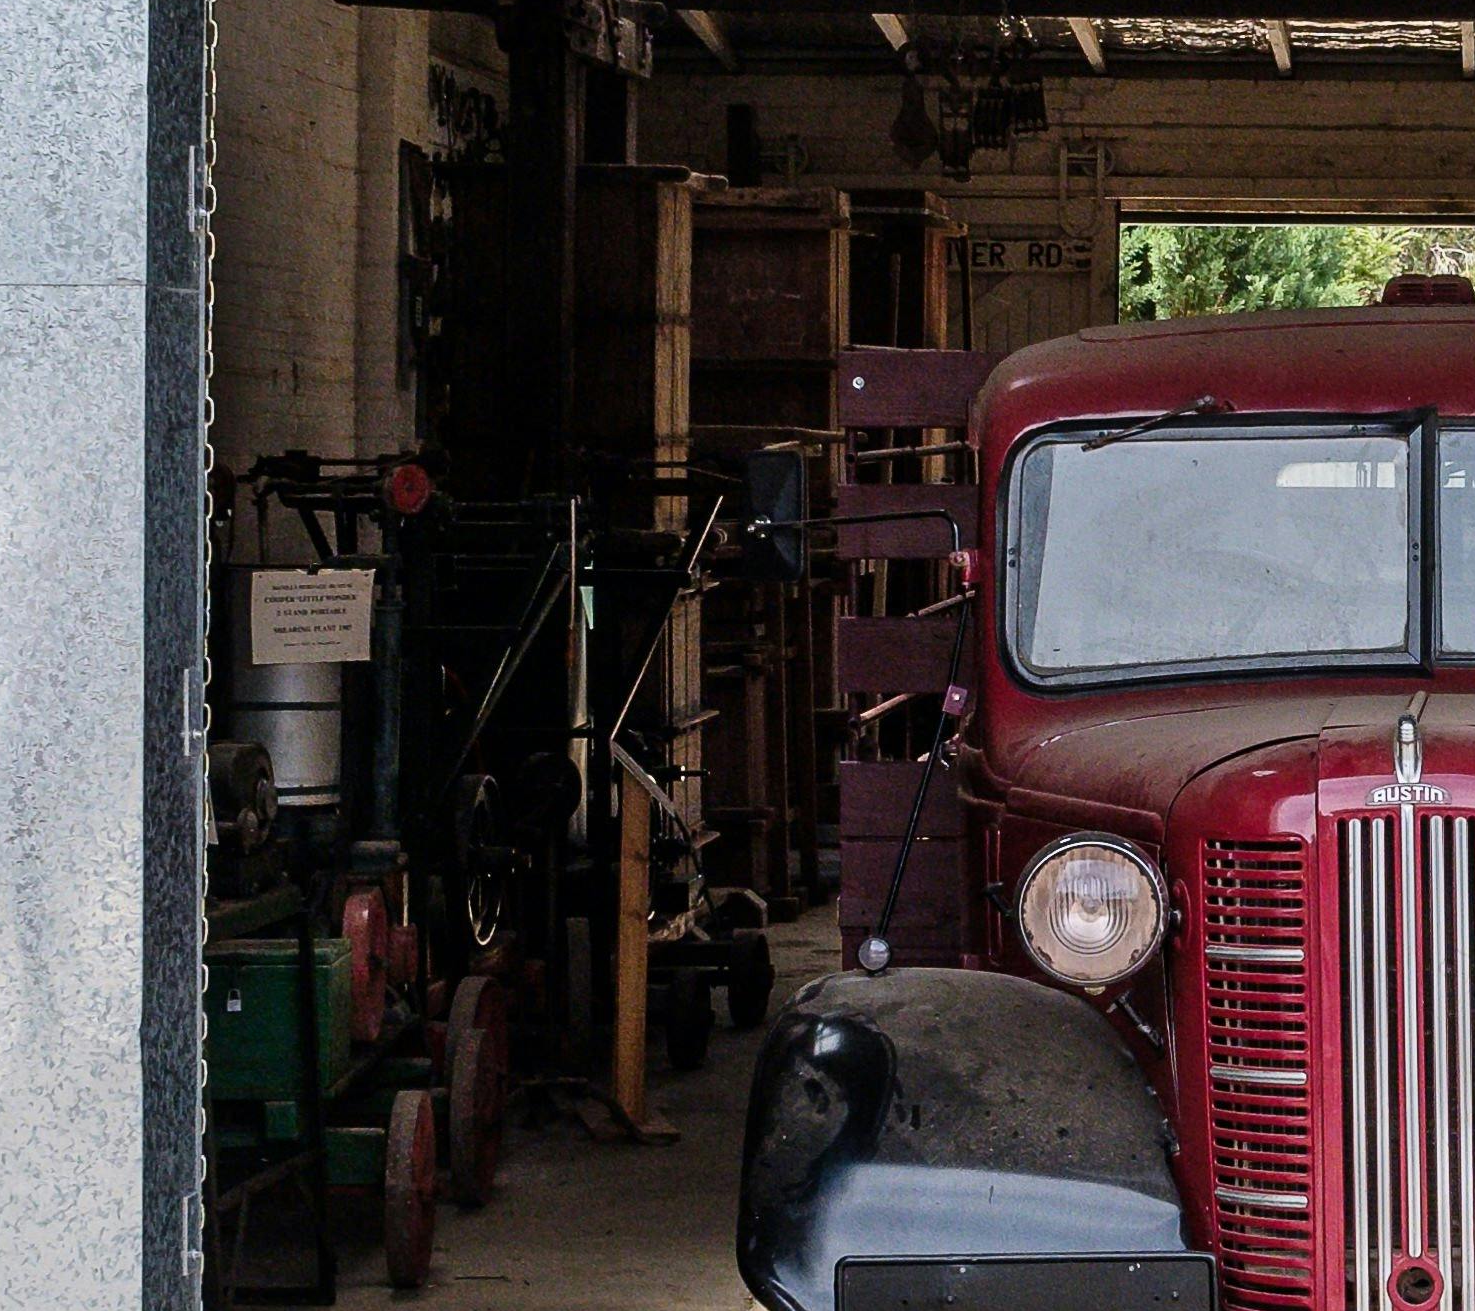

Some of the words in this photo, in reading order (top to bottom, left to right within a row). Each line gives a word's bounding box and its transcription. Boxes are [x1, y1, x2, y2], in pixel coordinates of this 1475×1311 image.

[947, 241, 1005, 267] IVER
[1028, 243, 1063, 267] RD
[1373, 786, 1443, 803] AUSTIN
